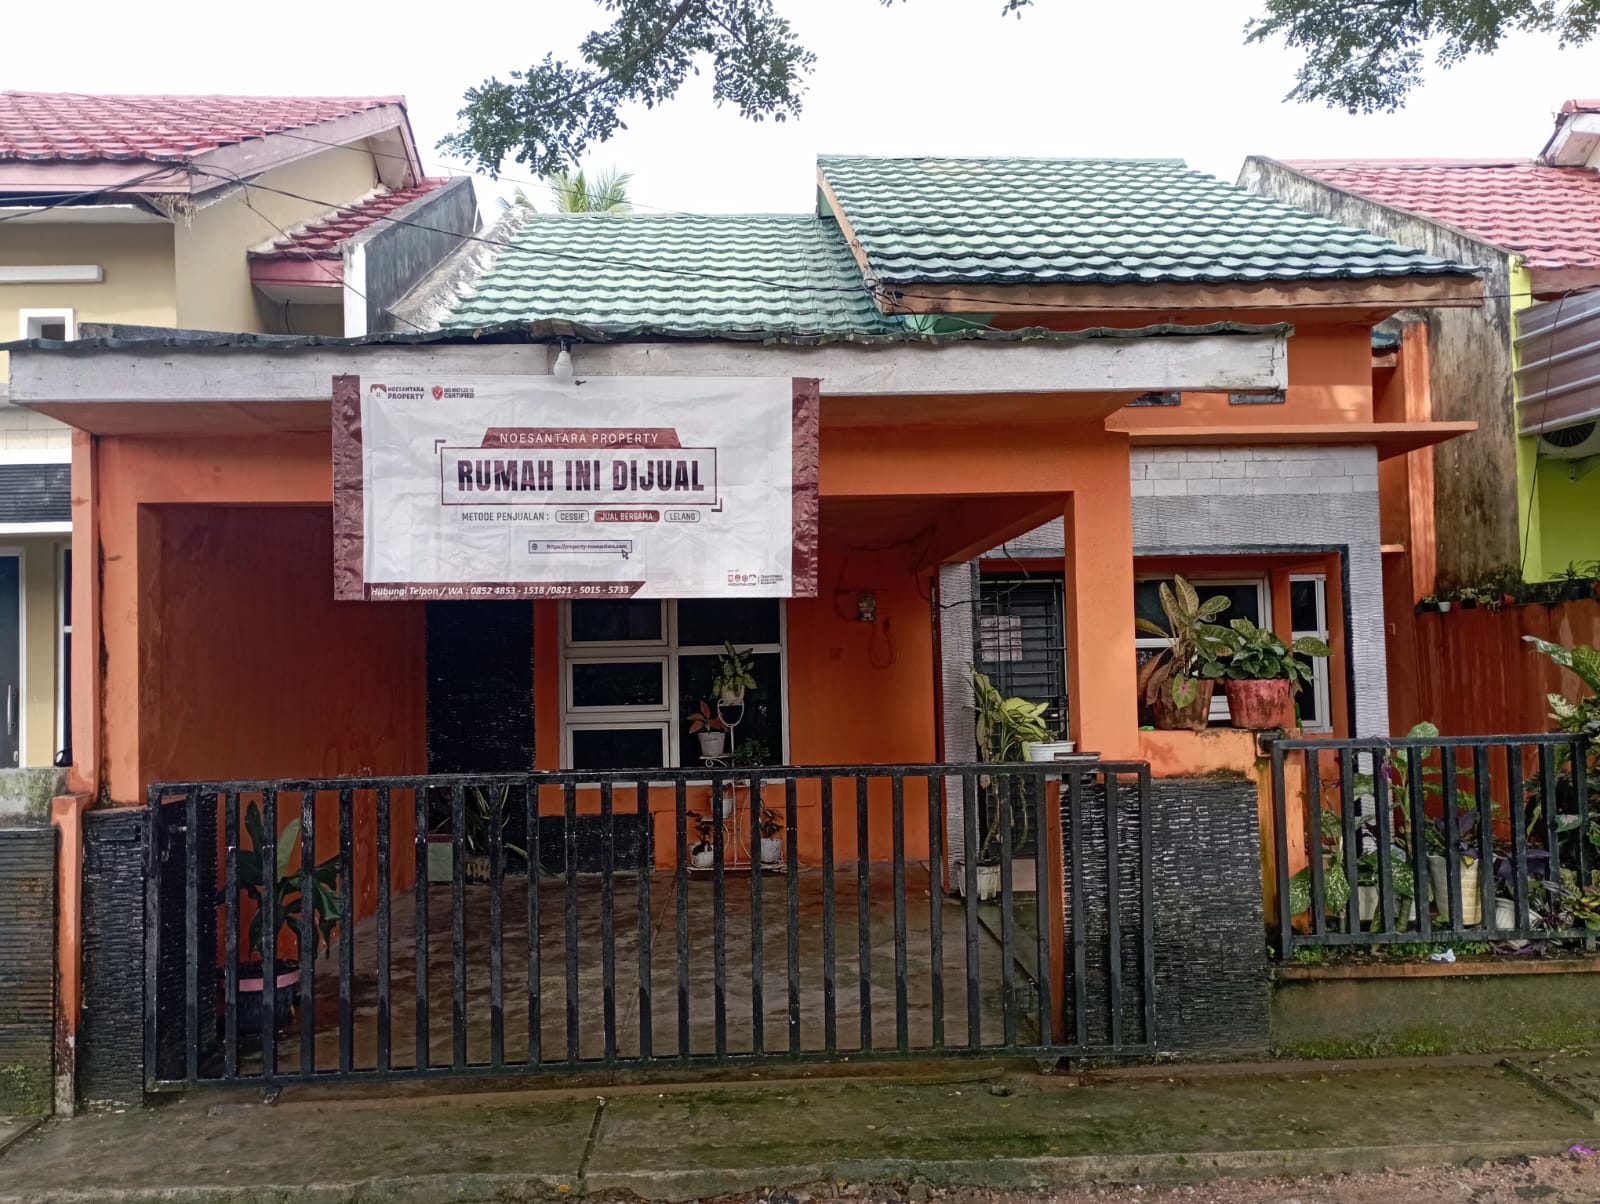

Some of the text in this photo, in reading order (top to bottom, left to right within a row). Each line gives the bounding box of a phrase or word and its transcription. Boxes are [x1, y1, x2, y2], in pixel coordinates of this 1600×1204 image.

[500, 433, 658, 444] NOESANTARA PROPERTY
[458, 460, 704, 492] RUMAH INI DIJUAL
[462, 512, 494, 521] METODE
[496, 512, 544, 521] PENJUALAN
[560, 512, 584, 520] CESSIE
[600, 512, 618, 520] JUAL
[620, 512, 654, 520] BERSAMA
[670, 512, 696, 520] LELANG
[371, 586, 407, 596] Hubungi
[410, 586, 438, 596] Telpon
[448, 587, 464, 595] WA
[470, 587, 492, 595] 0852
[494, 587, 516, 595] 4853
[523, 586, 544, 594] 1518
[608, 586, 630, 594] 5733
